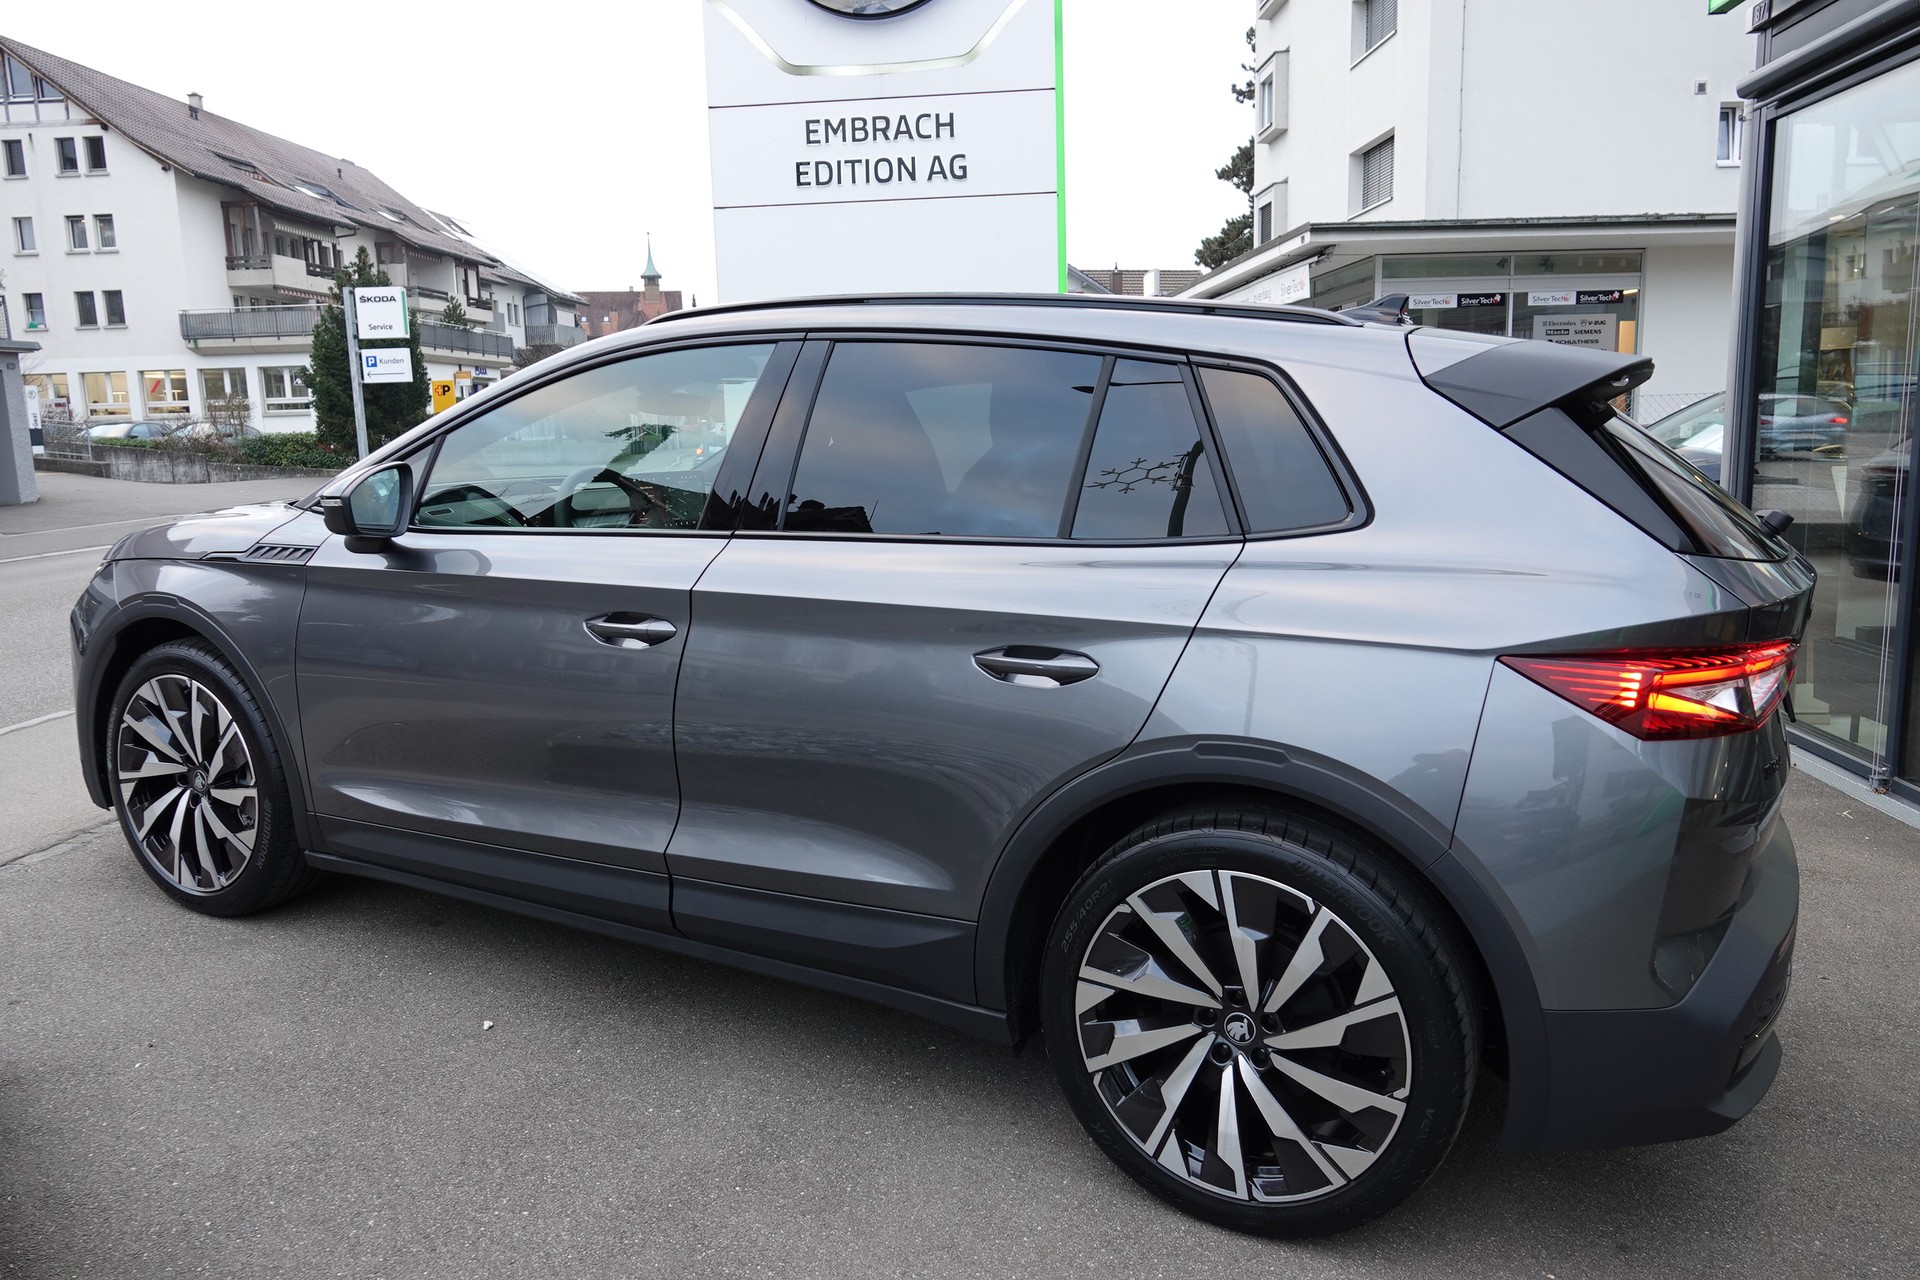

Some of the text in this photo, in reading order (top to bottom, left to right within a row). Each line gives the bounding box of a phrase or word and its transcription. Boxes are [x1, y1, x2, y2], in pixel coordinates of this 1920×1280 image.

[805, 112, 955, 146] EMBRACH
[795, 154, 968, 187] EDITION AG
[359, 295, 397, 303] ŠKODA
[1548, 319, 1577, 327] Electrolux
[379, 357, 405, 365] Kunden
